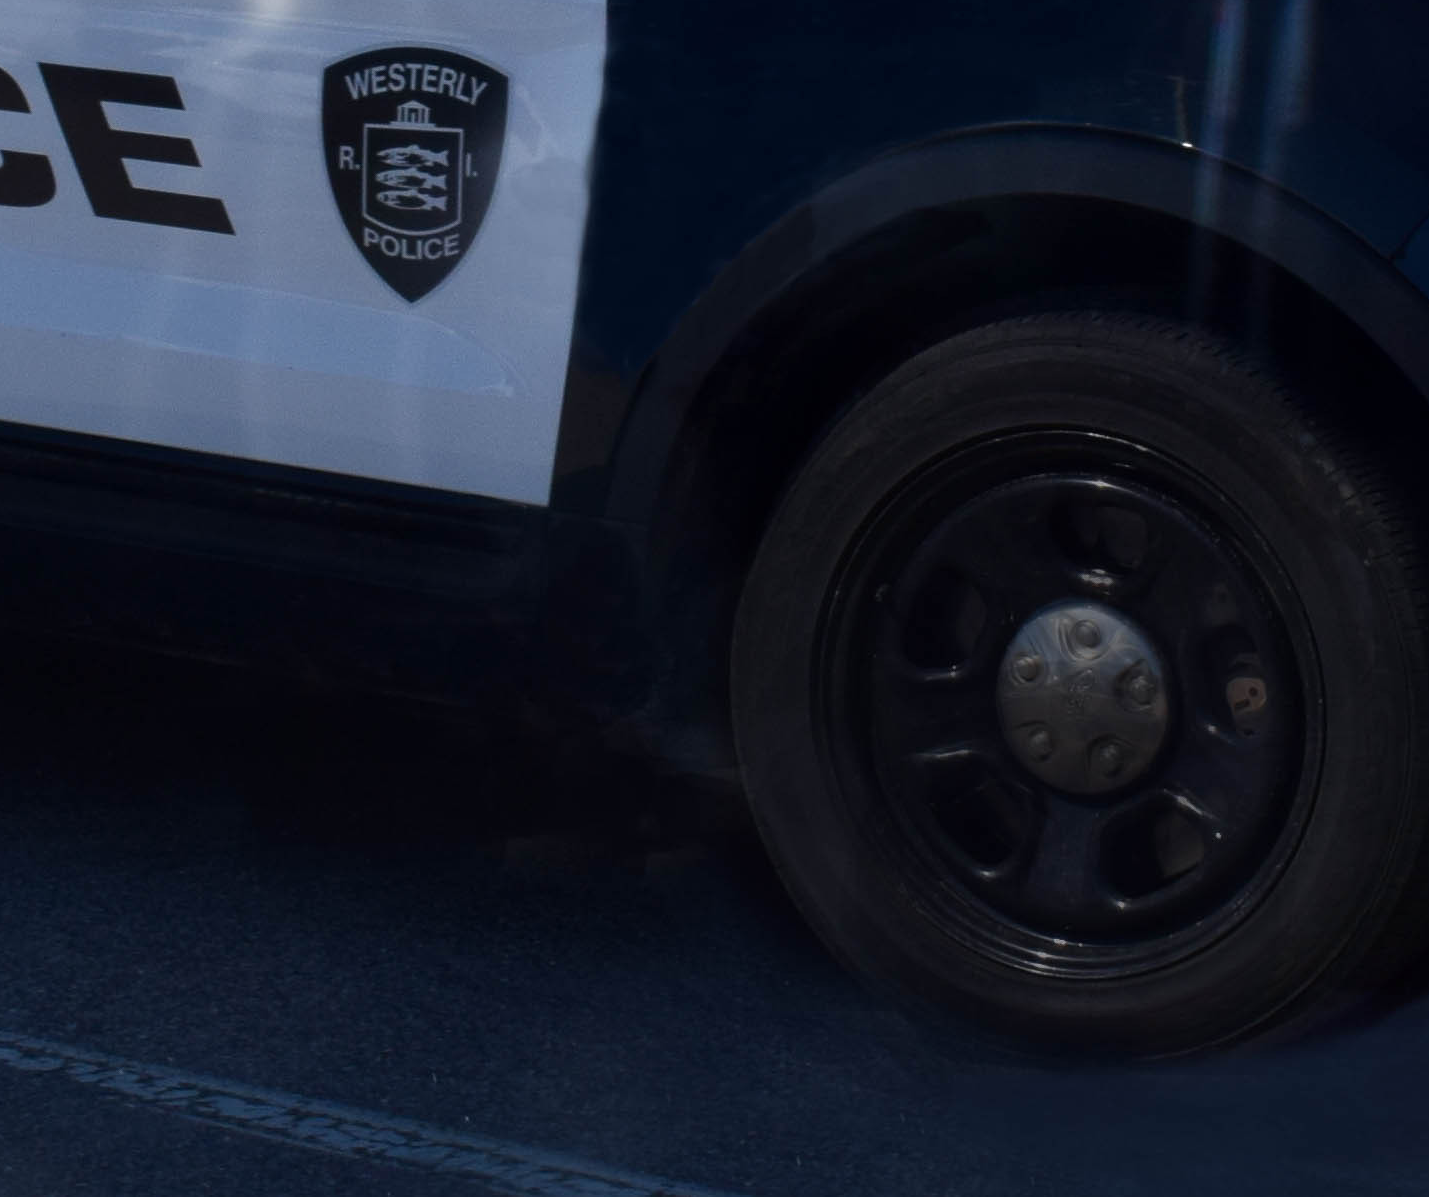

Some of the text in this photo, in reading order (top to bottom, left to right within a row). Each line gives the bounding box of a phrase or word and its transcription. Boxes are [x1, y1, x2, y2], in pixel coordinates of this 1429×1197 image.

[345, 62, 488, 106] WESTERLY
[338, 145, 361, 171] R.
[363, 228, 461, 260] POLICE
